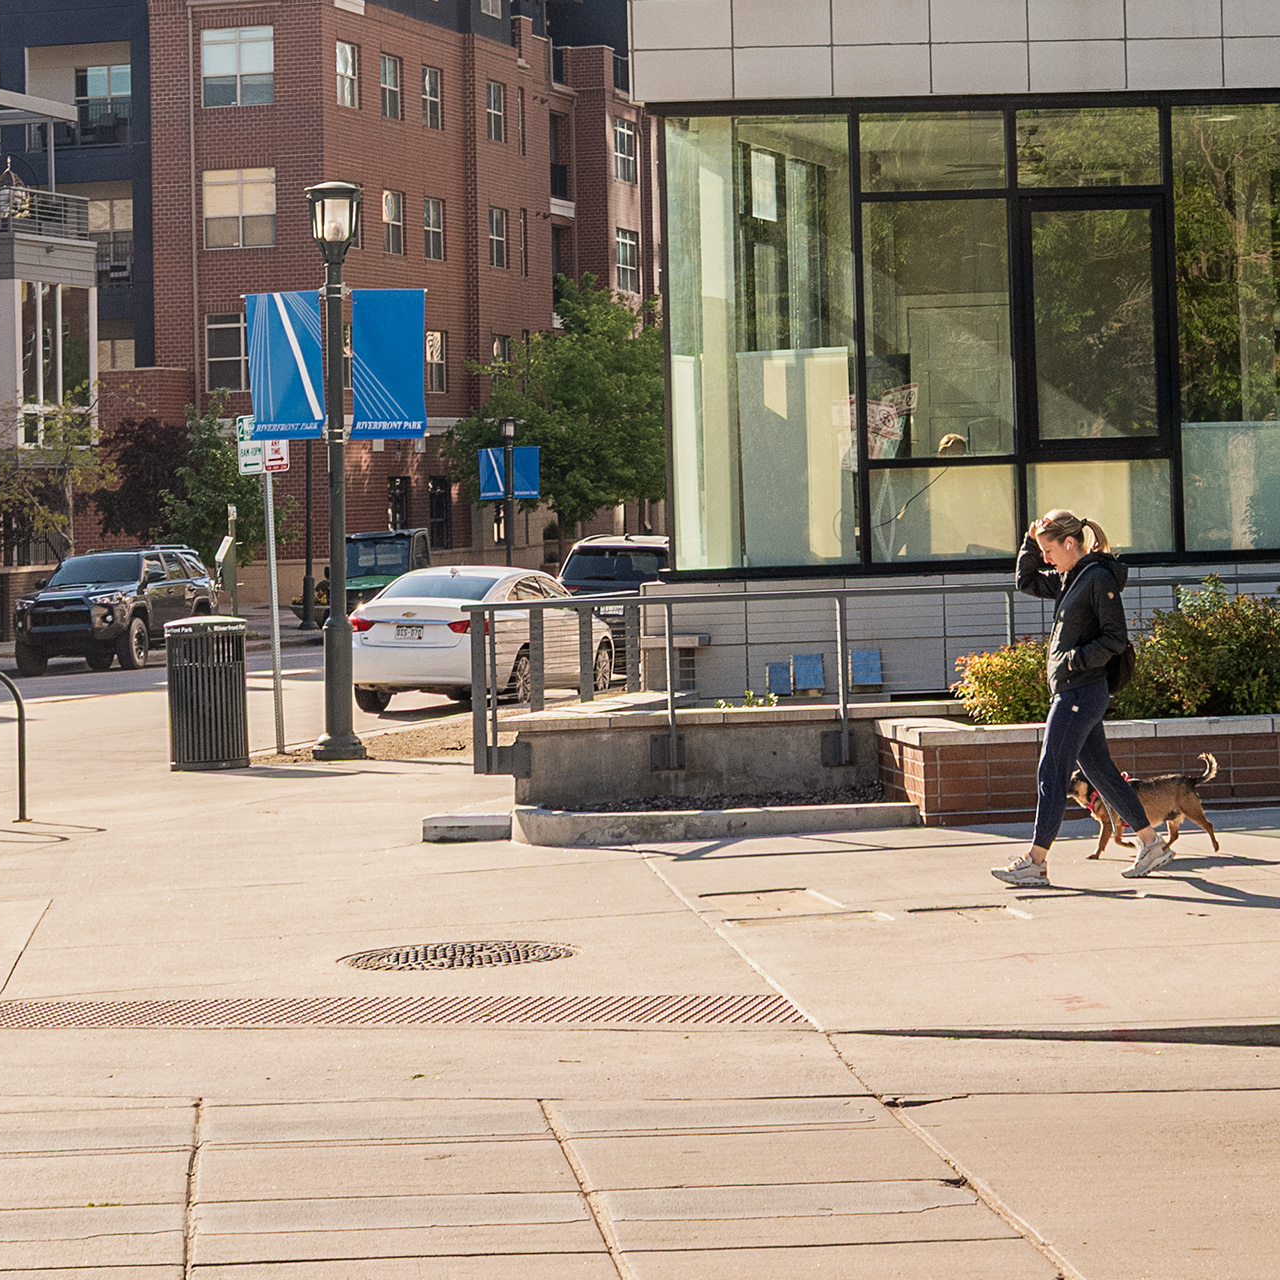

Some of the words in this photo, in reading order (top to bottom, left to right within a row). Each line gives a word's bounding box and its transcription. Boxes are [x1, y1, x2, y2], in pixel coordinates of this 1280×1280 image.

[256, 423, 301, 432] RIVERFRONT
[301, 422, 318, 430] PARK
[355, 421, 403, 430] RIVERFRONT
[403, 421, 423, 430] PARK
